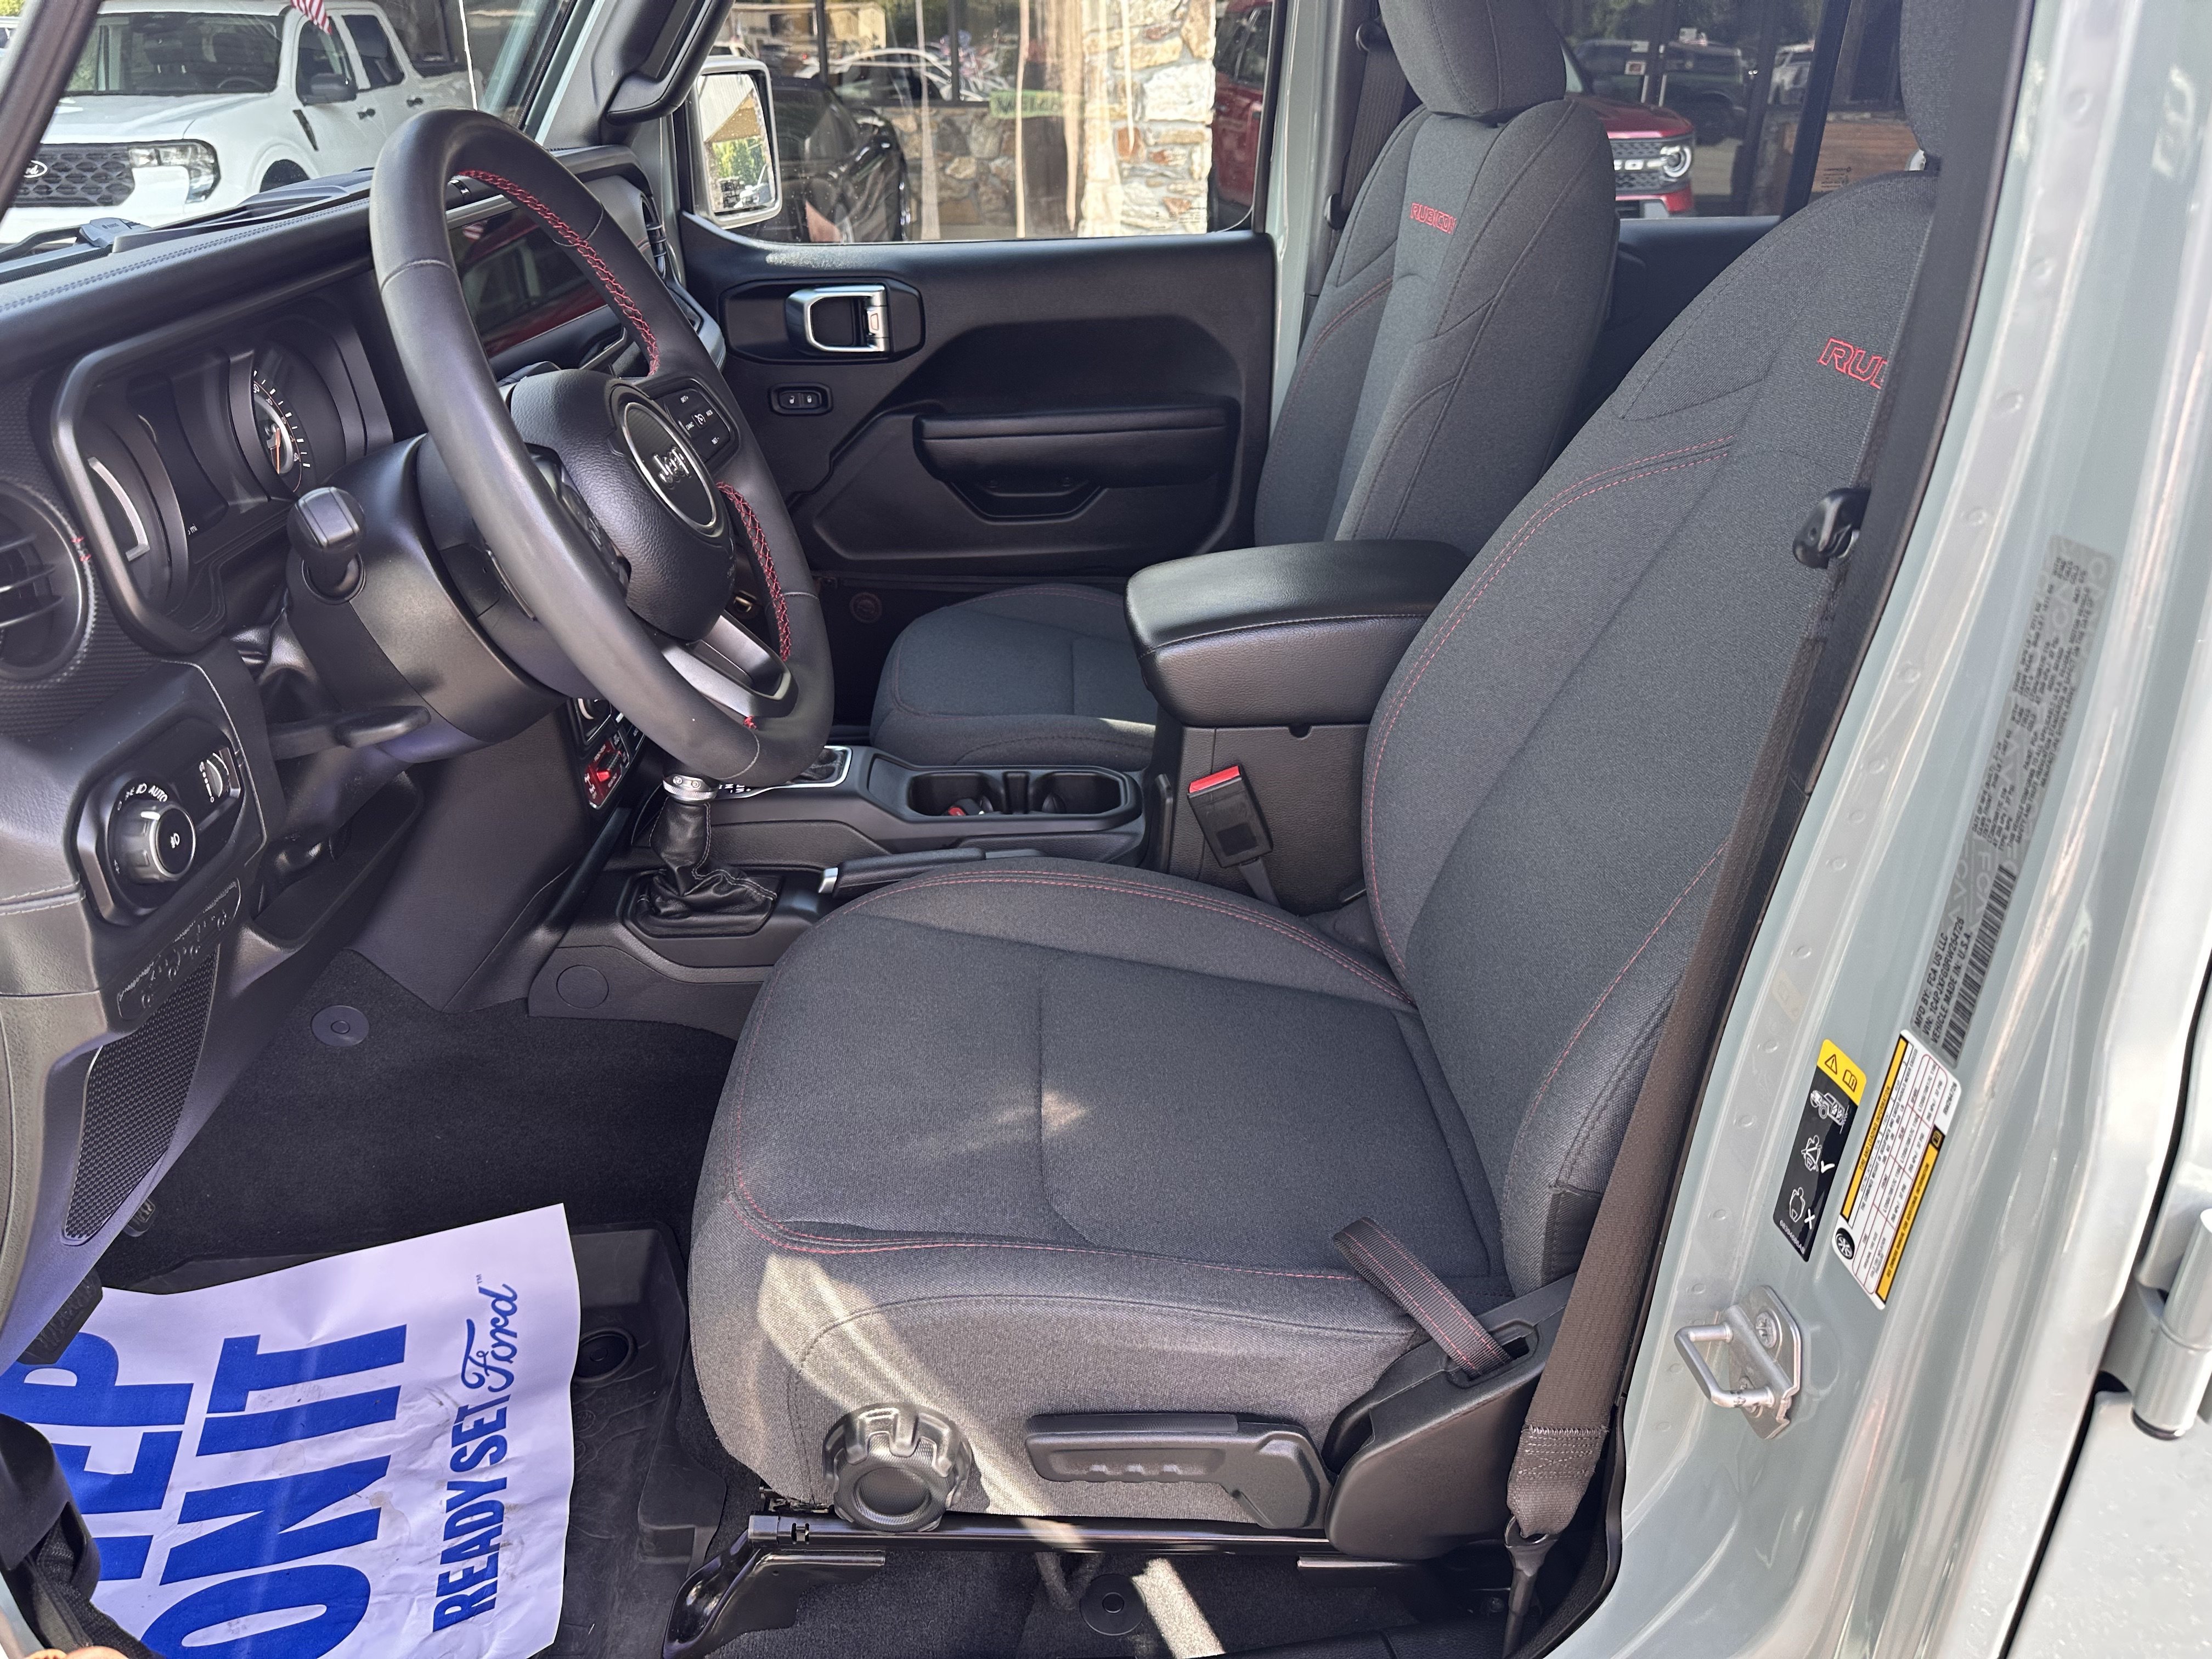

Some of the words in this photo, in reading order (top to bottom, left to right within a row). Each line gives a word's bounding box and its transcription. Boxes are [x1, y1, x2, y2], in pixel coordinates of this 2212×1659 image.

[1409, 202, 1457, 236] RUBICON
[149, 785, 168, 802] AUTO
[1957, 933, 1972, 959] U.S.A.
[1915, 1006, 1925, 1028] MFD
[1921, 989, 1931, 1005] BY:
[1927, 968, 1937, 986] FCA
[1933, 951, 1942, 966] US
[1938, 933, 1948, 951] LLC
[1953, 962, 1962, 976] IN:
[1944, 976, 1956, 1005] MADE
[1922, 1017, 1933, 1035] VIN:
[1931, 1005, 1947, 1043] VEHICLE
[460, 1283, 518, 1392] Ford
[450, 1393, 511, 1472] SET
[432, 1476, 508, 1633] READY
